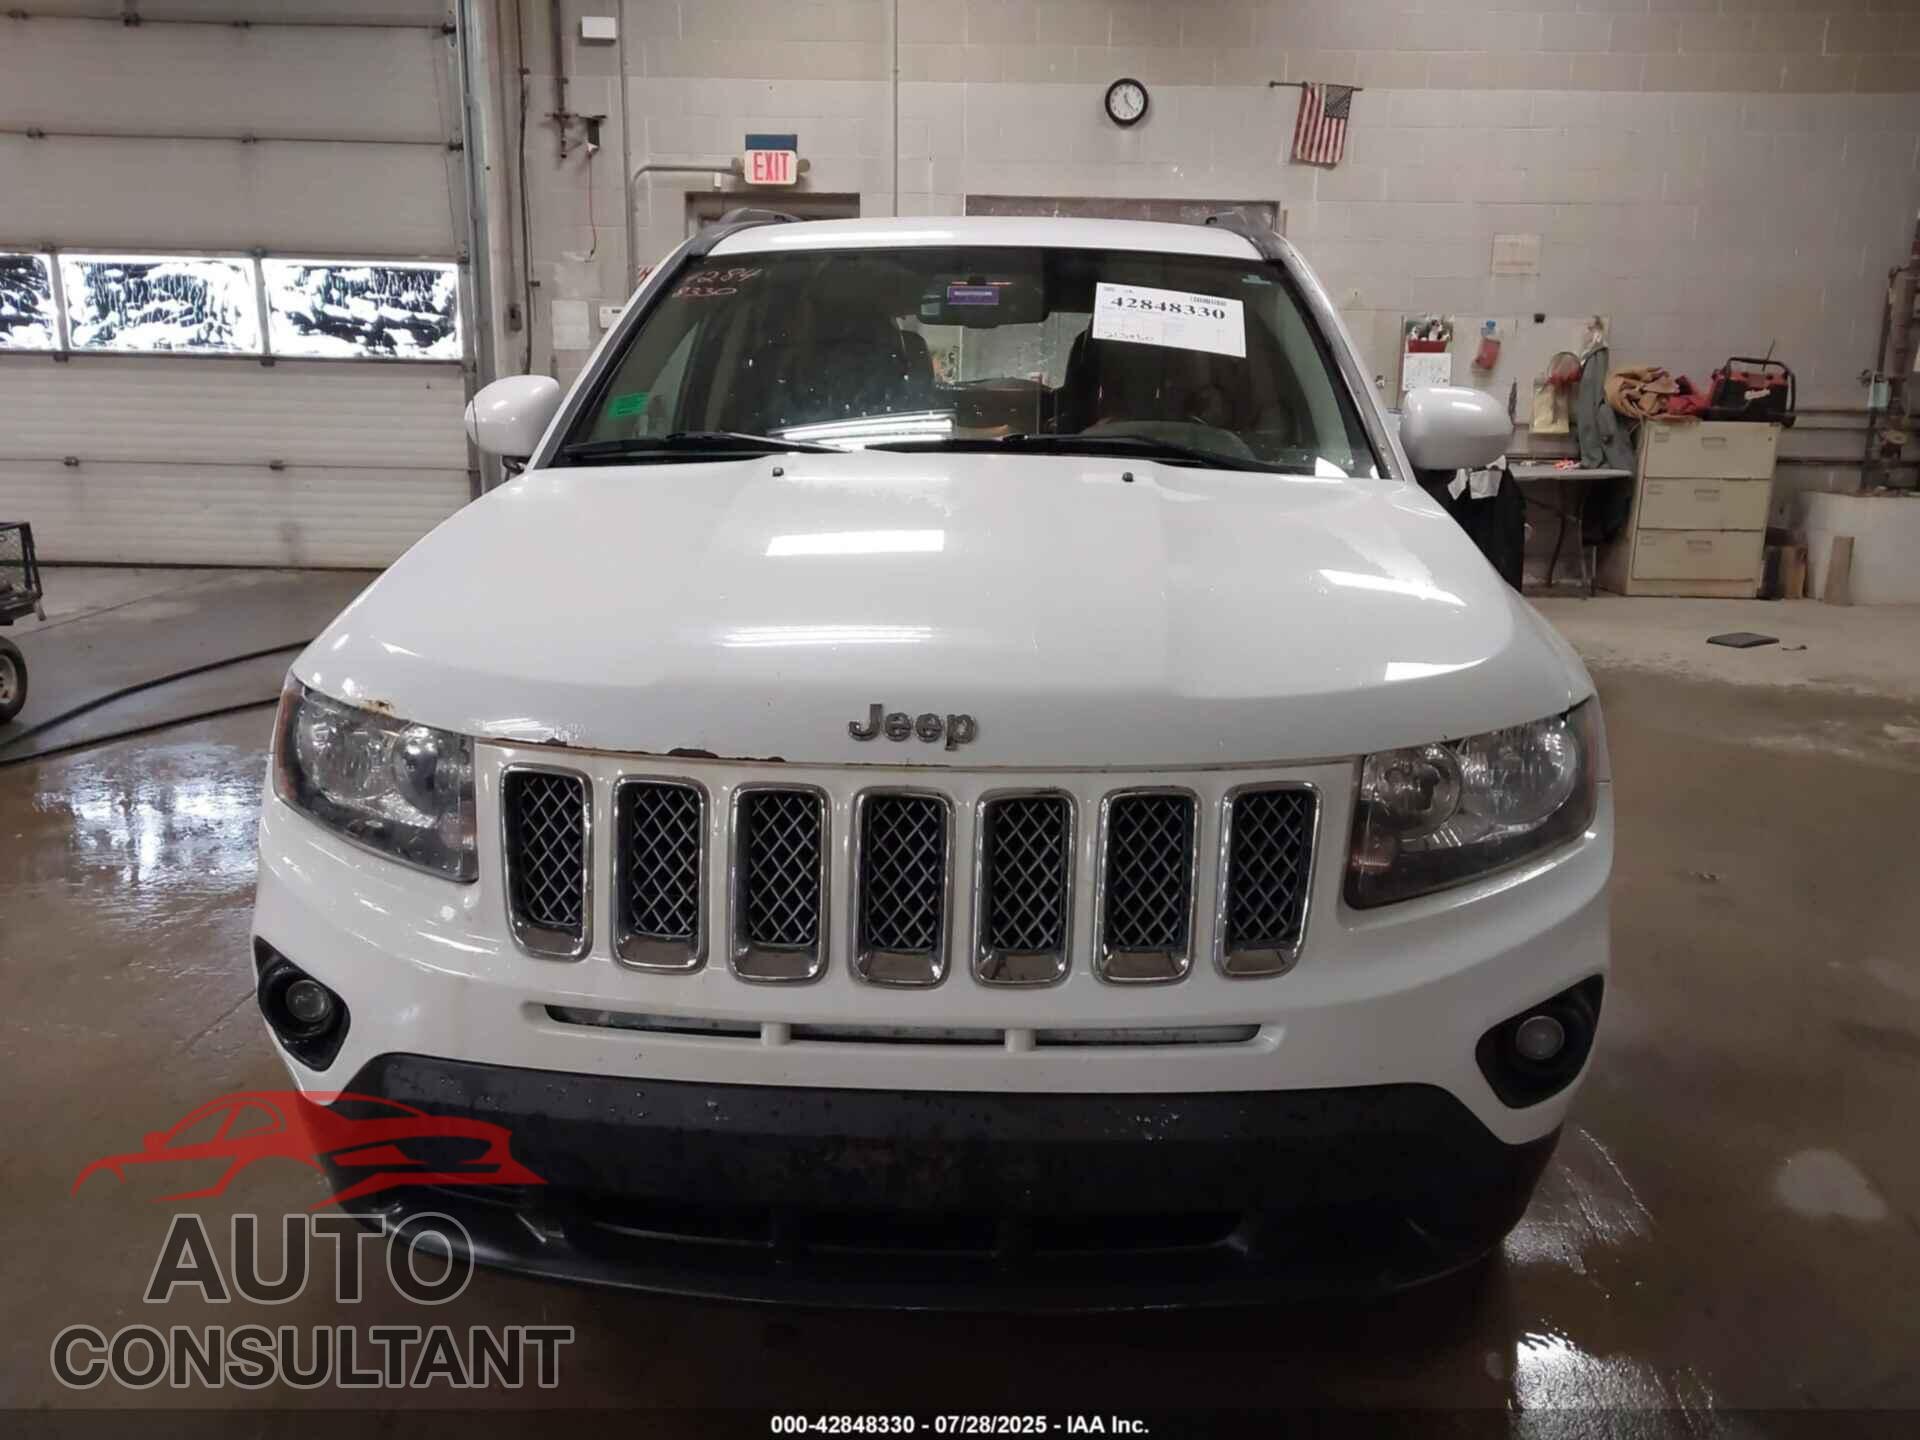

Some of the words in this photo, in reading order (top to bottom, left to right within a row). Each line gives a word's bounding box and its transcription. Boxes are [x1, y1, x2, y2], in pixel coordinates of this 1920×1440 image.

[753, 151, 790, 181] EXIT
[1110, 297, 1226, 320] 42848330
[849, 703, 978, 752] Jeep
